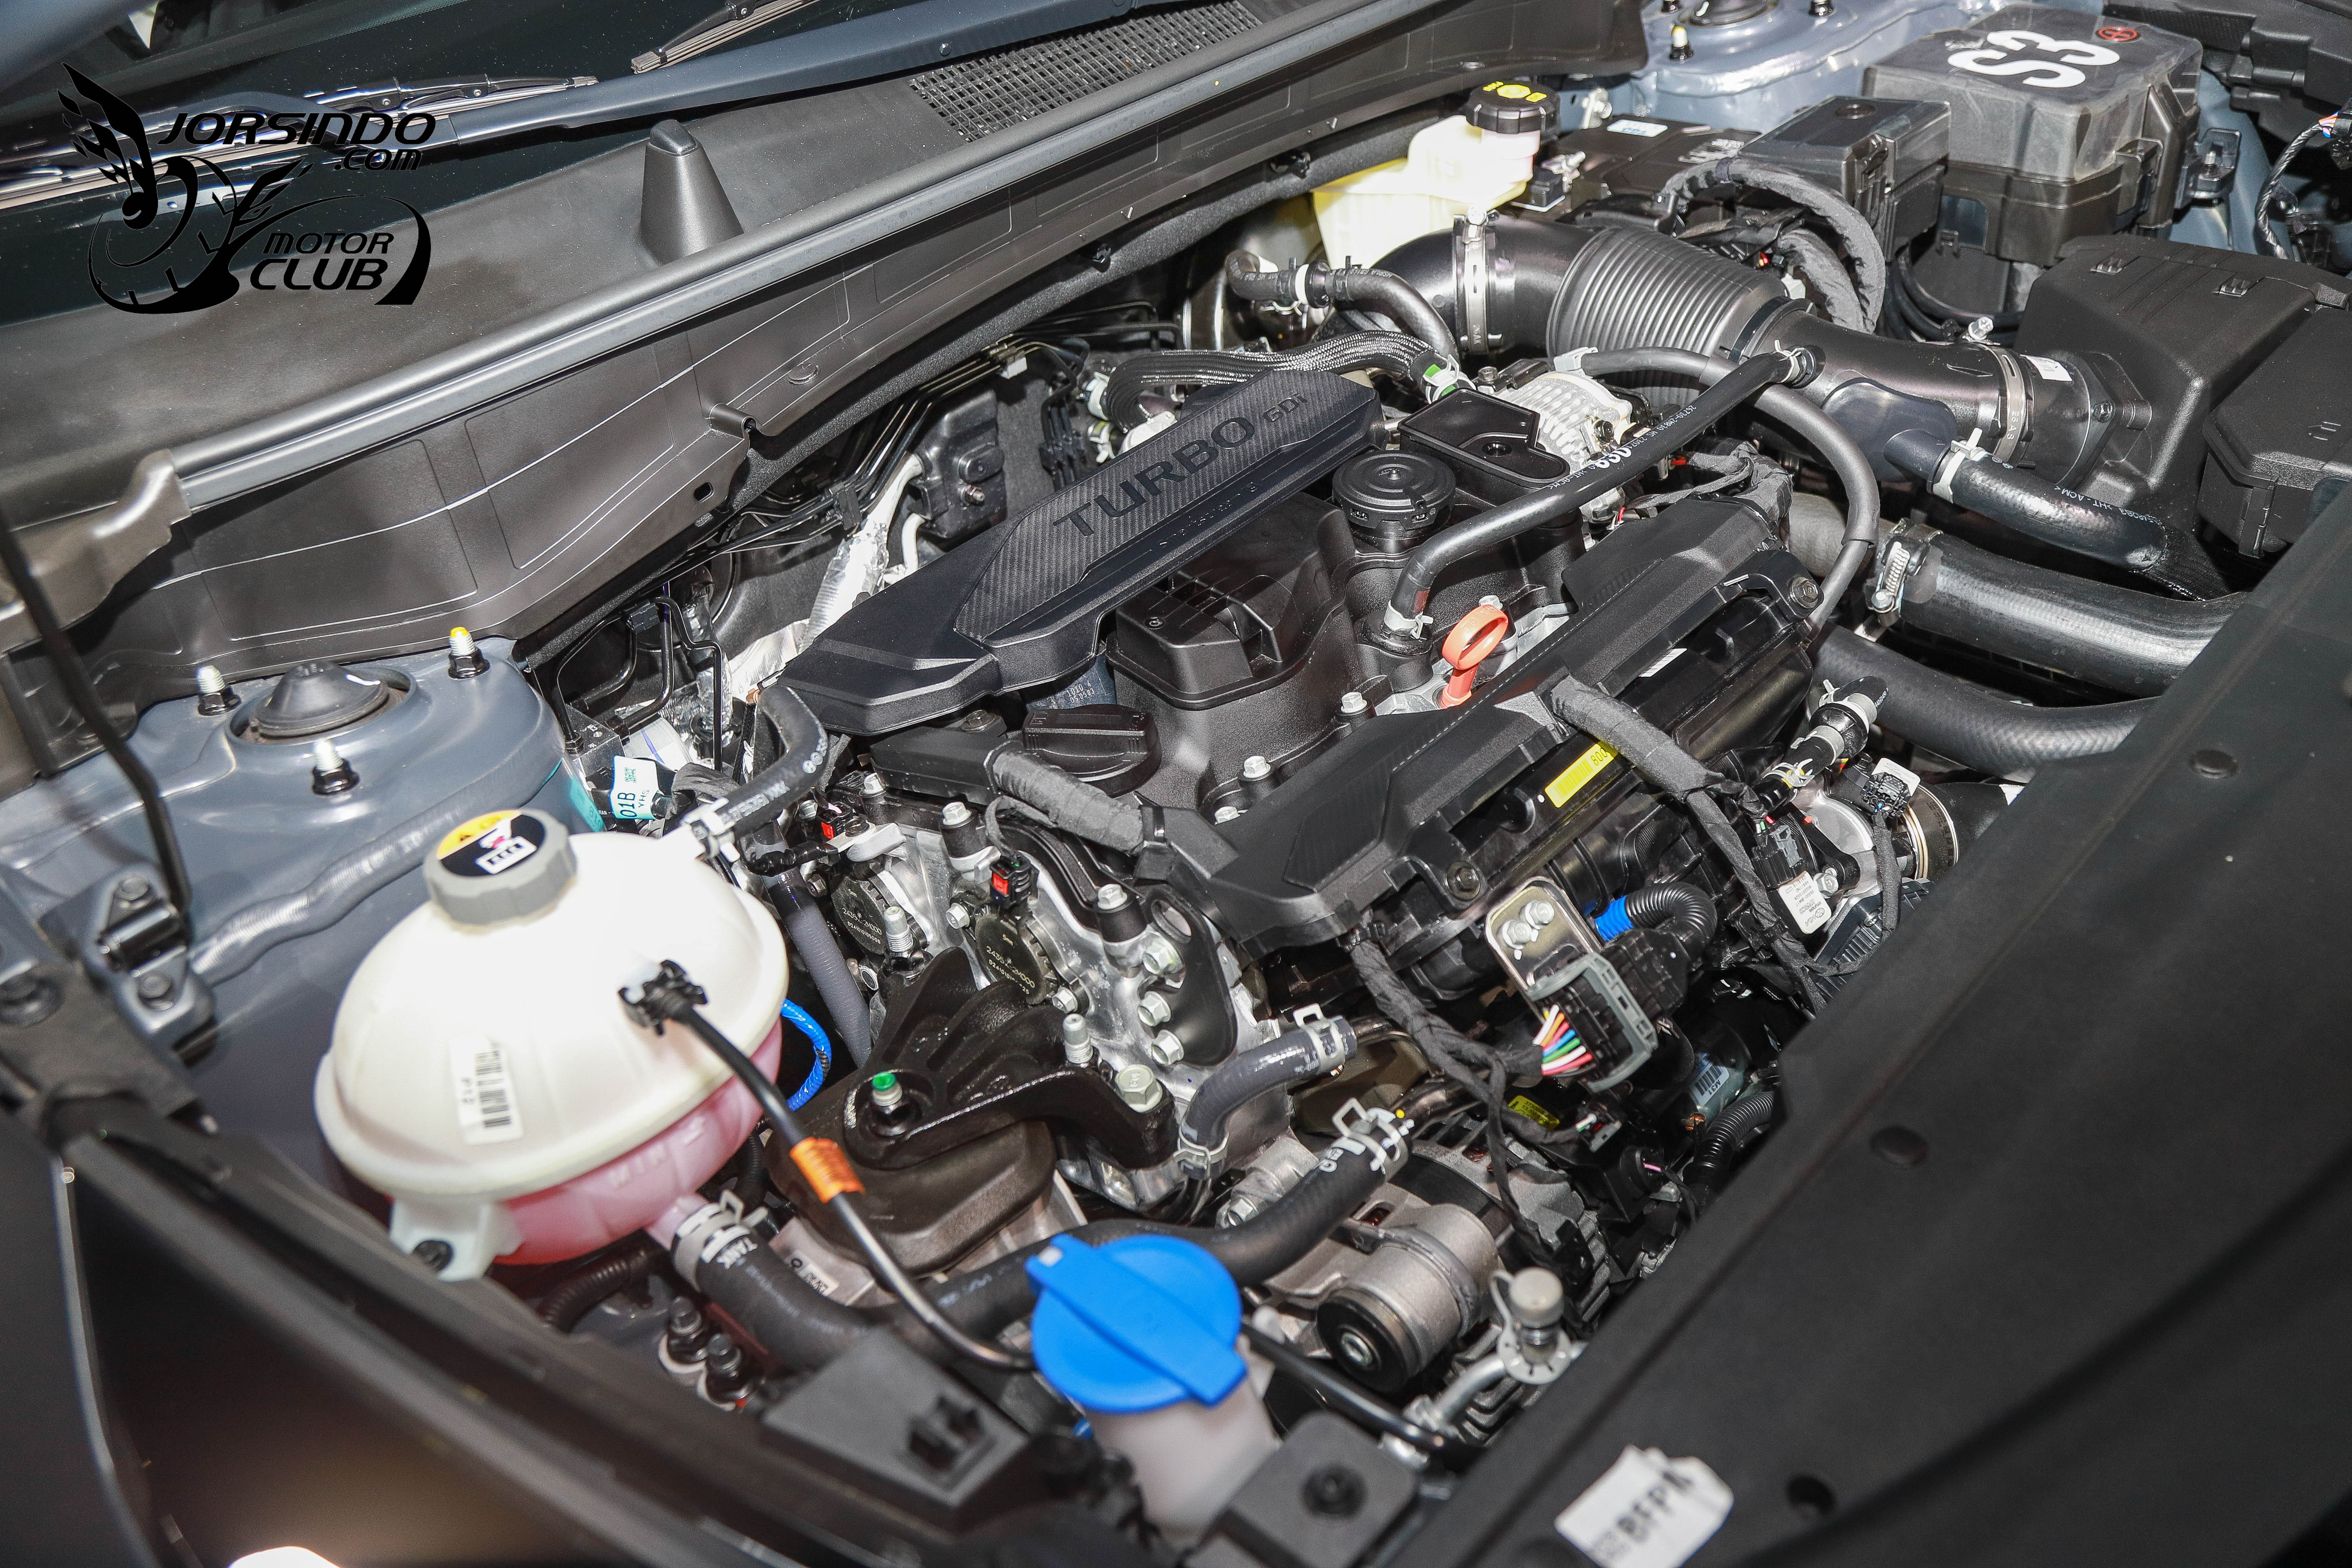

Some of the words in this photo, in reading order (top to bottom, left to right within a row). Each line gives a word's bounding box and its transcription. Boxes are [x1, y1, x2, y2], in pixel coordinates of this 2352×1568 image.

[1948, 29, 2121, 88] S3
[1263, 392, 1309, 423] GDI
[1052, 416, 1255, 536] TURBO
[1591, 747, 1608, 766] 800
[617, 792, 637, 817] 01B
[638, 790, 649, 808] YHS
[1708, 1079, 1721, 1095] M31
